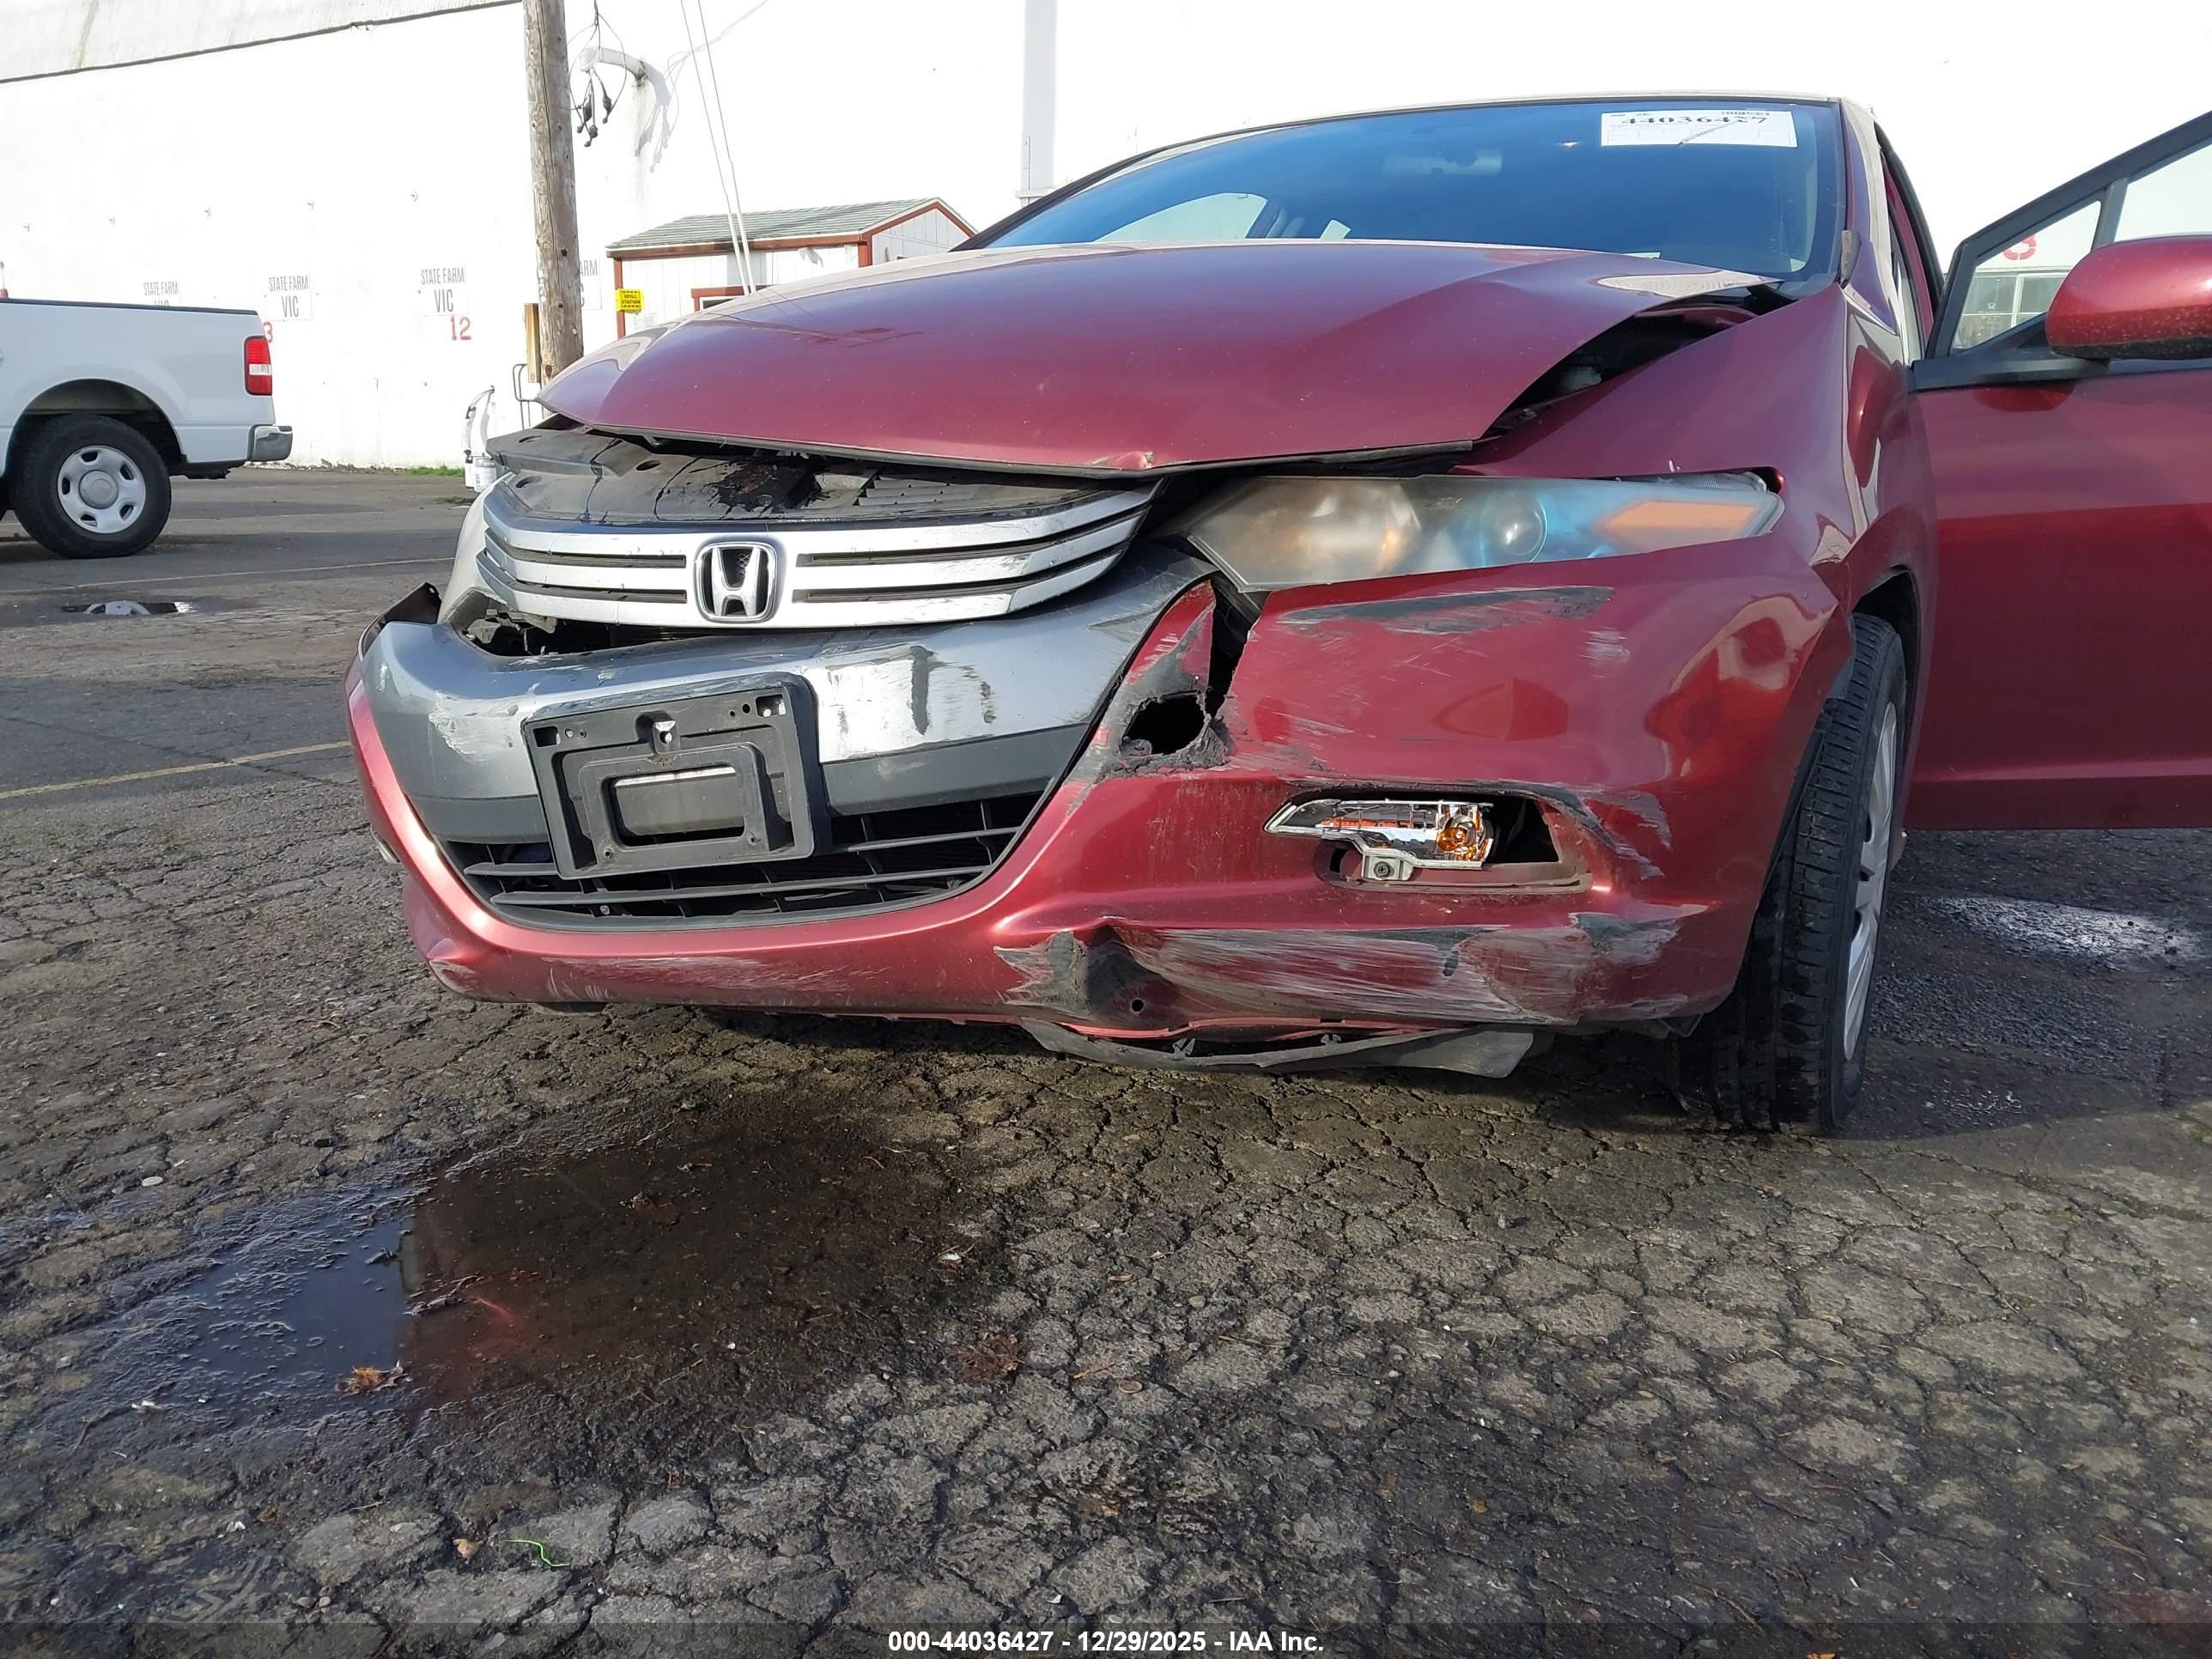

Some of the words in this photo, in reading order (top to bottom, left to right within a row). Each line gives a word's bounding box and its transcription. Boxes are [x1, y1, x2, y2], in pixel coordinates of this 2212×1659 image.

[421, 268, 441, 285] STATE
[443, 267, 465, 283] FARM
[580, 259, 598, 276] ARM
[143, 282, 160, 295] STATE
[161, 281, 178, 295] FARM
[268, 276, 288, 292] STATE
[289, 275, 309, 290] FARM
[281, 295, 299, 317] VIC
[434, 289, 453, 313] VIC
[450, 316, 471, 340] 12
